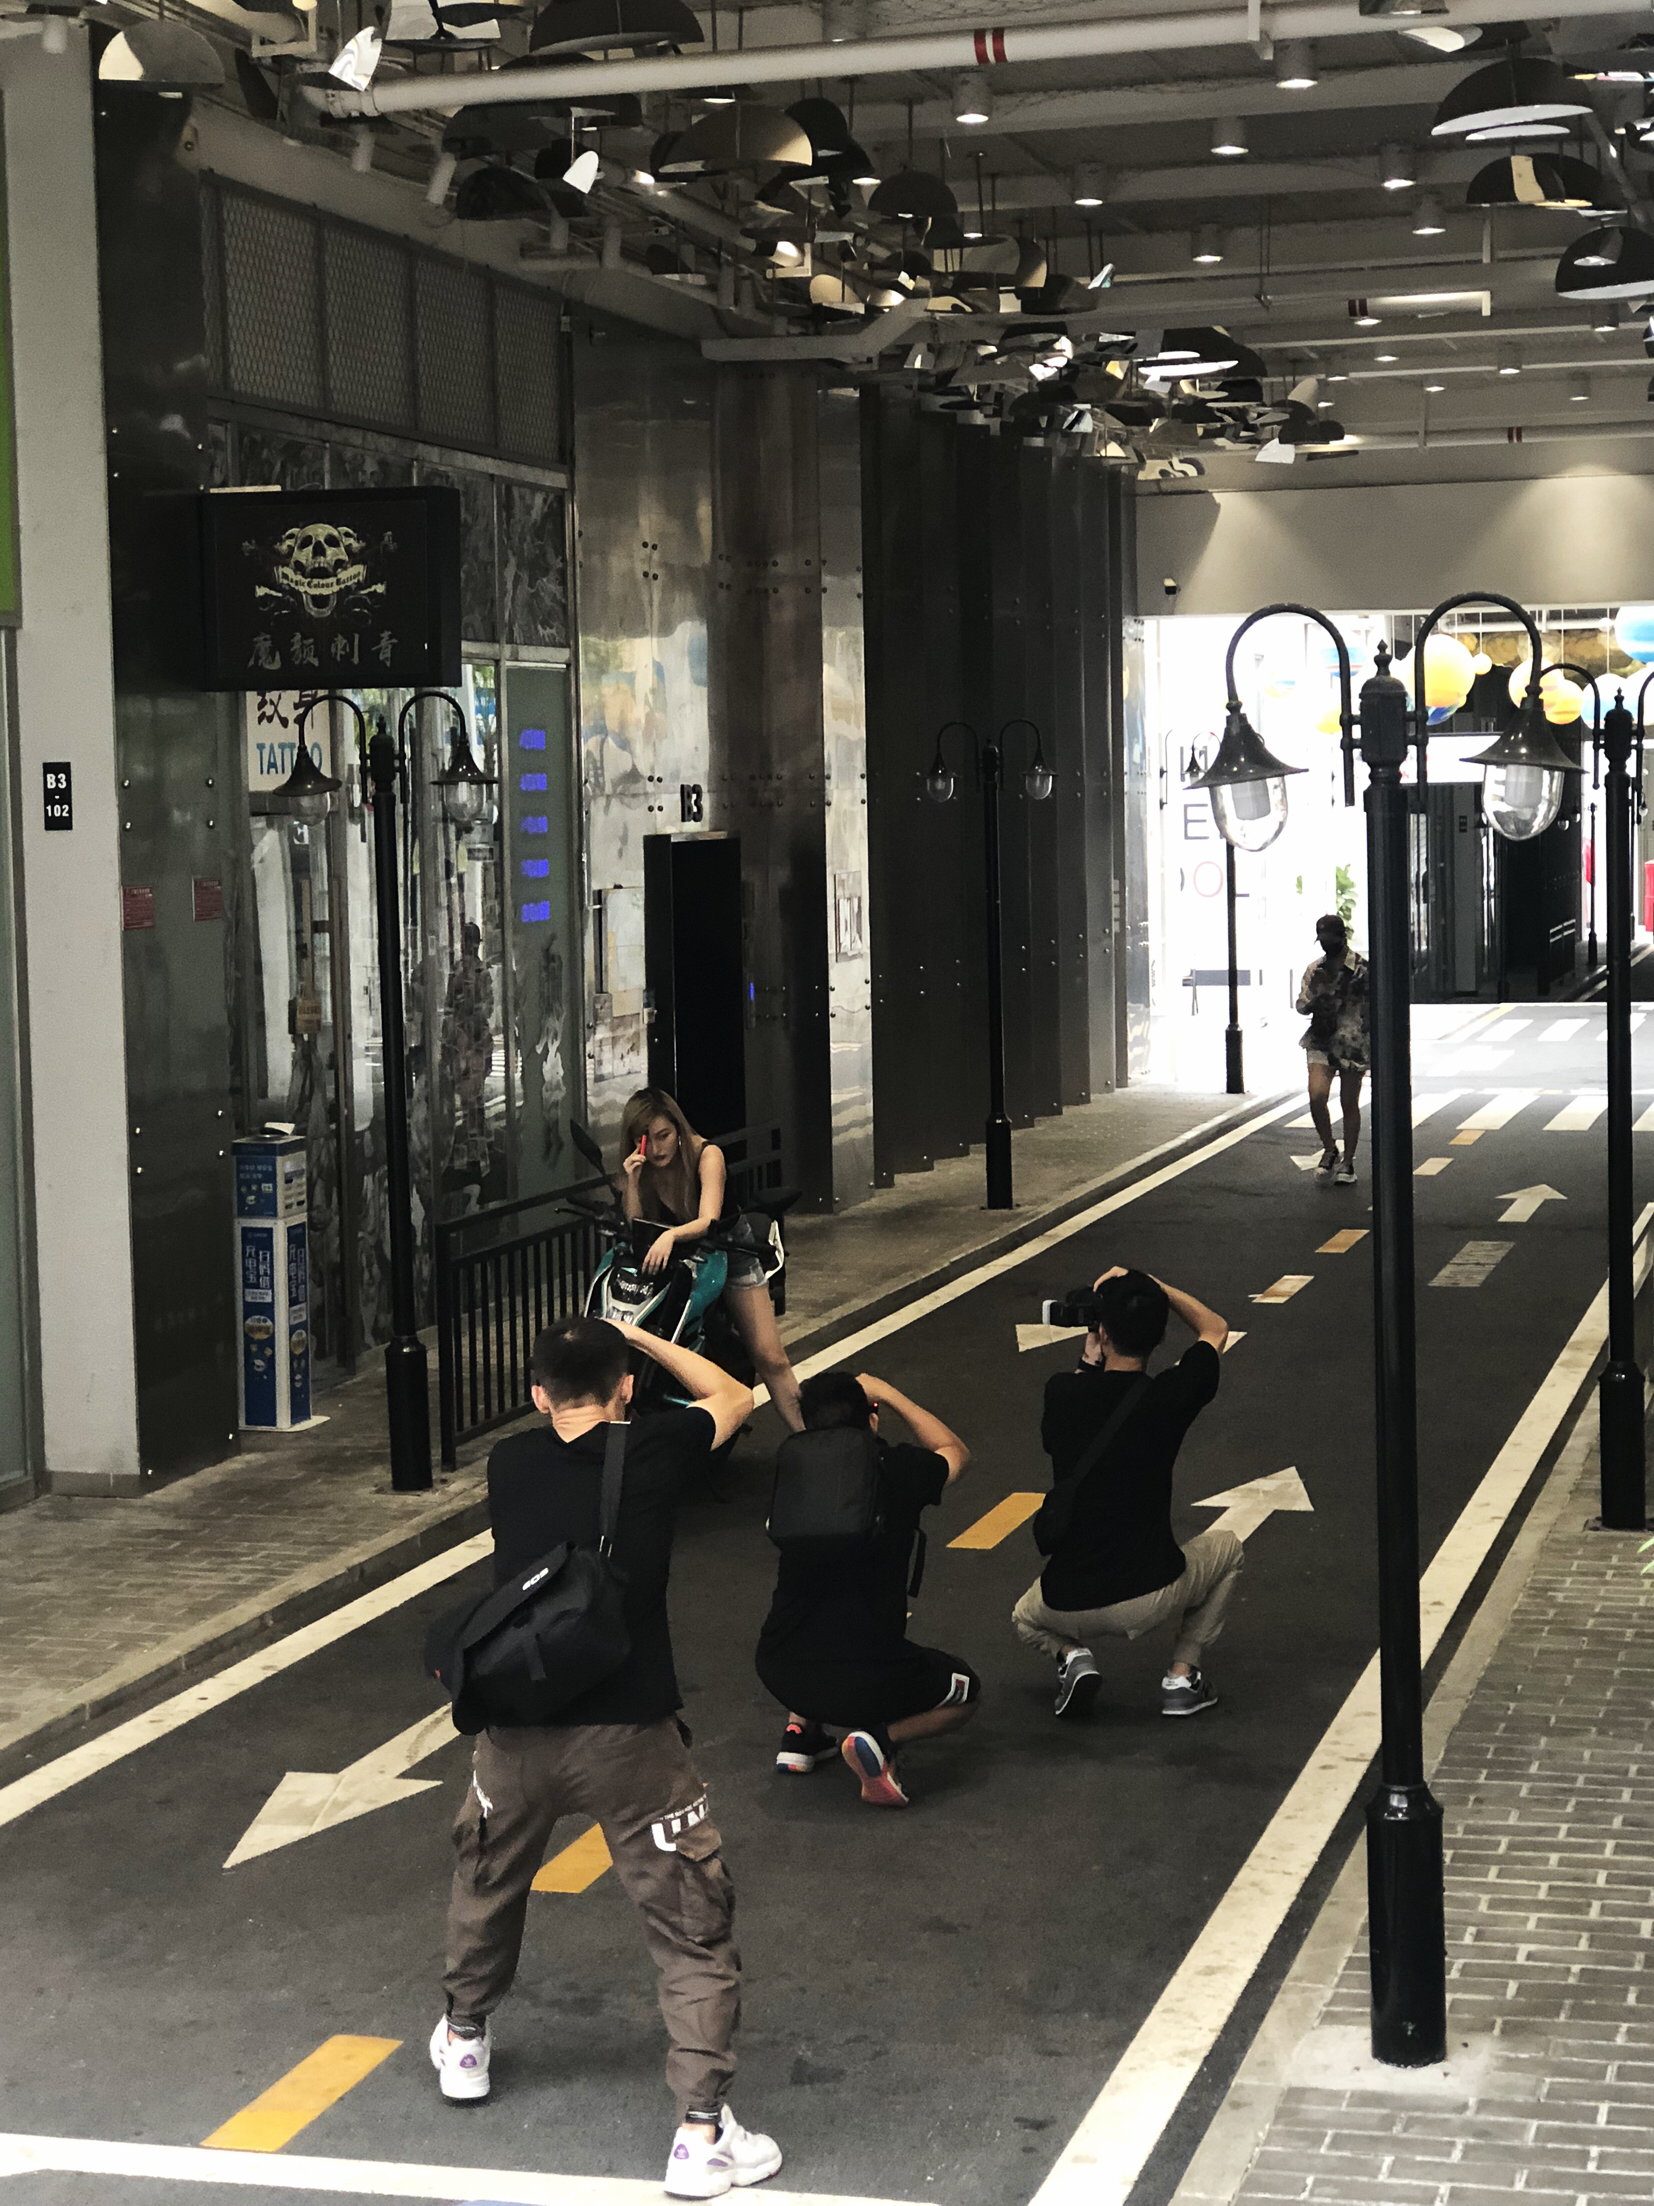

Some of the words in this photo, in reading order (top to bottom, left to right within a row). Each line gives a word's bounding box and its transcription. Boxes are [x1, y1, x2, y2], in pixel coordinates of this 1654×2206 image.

[256, 742, 322, 775] TATTO
[46, 773, 67, 789] B3
[46, 804, 70, 817] 102
[680, 784, 704, 822] B3
